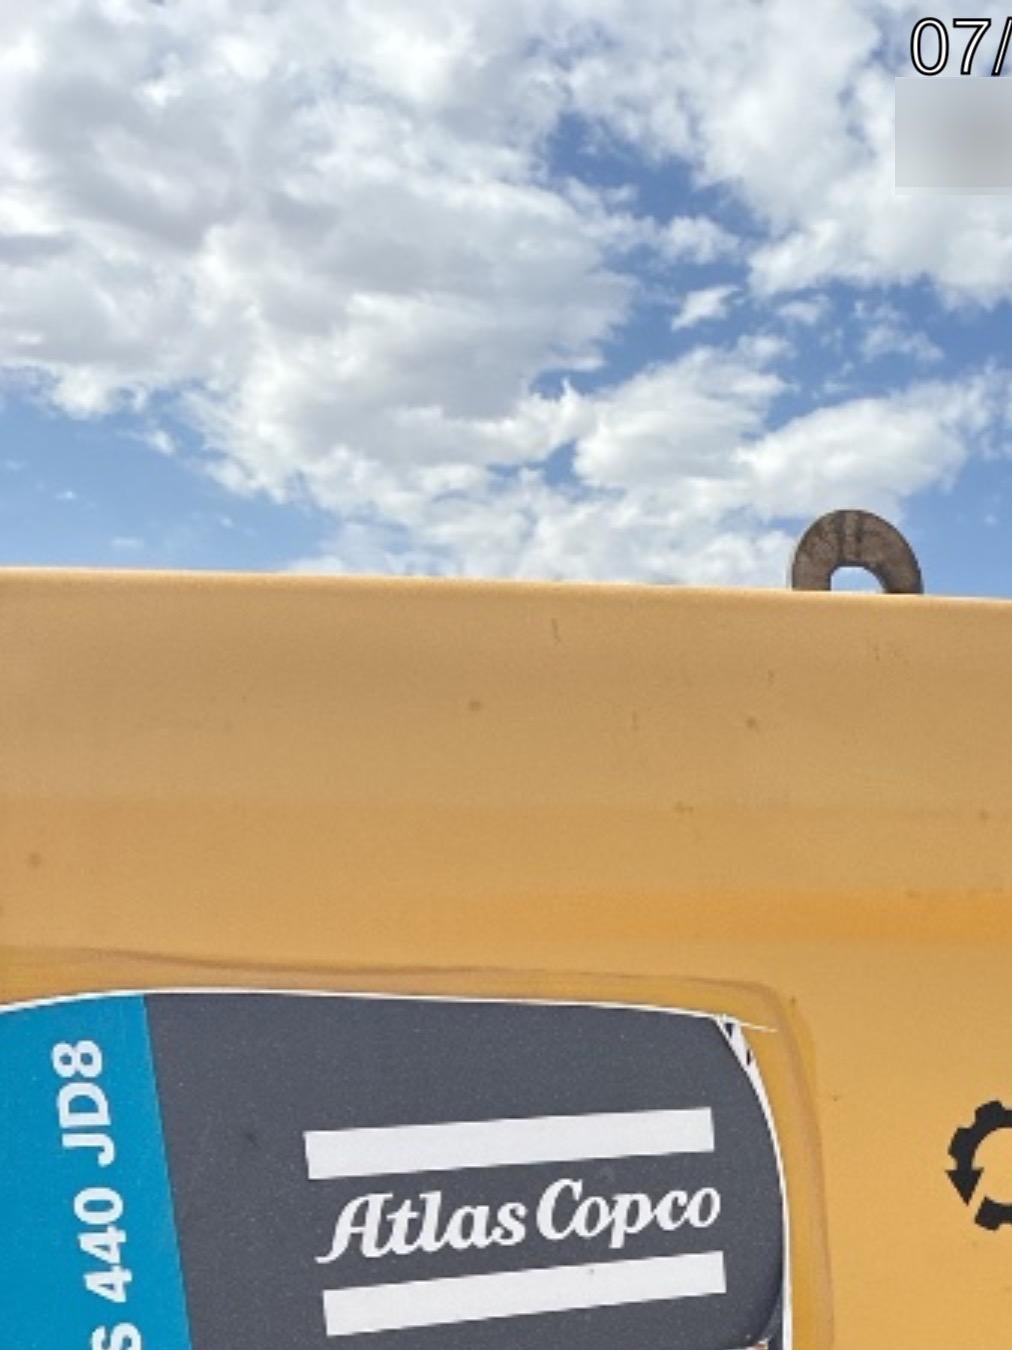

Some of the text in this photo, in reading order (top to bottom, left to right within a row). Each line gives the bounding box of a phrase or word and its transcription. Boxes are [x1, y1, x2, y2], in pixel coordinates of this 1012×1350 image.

[52, 1040, 115, 1166] JD8
[73, 1187, 132, 1303] 440
[314, 1178, 722, 1265] Atlas Copco
